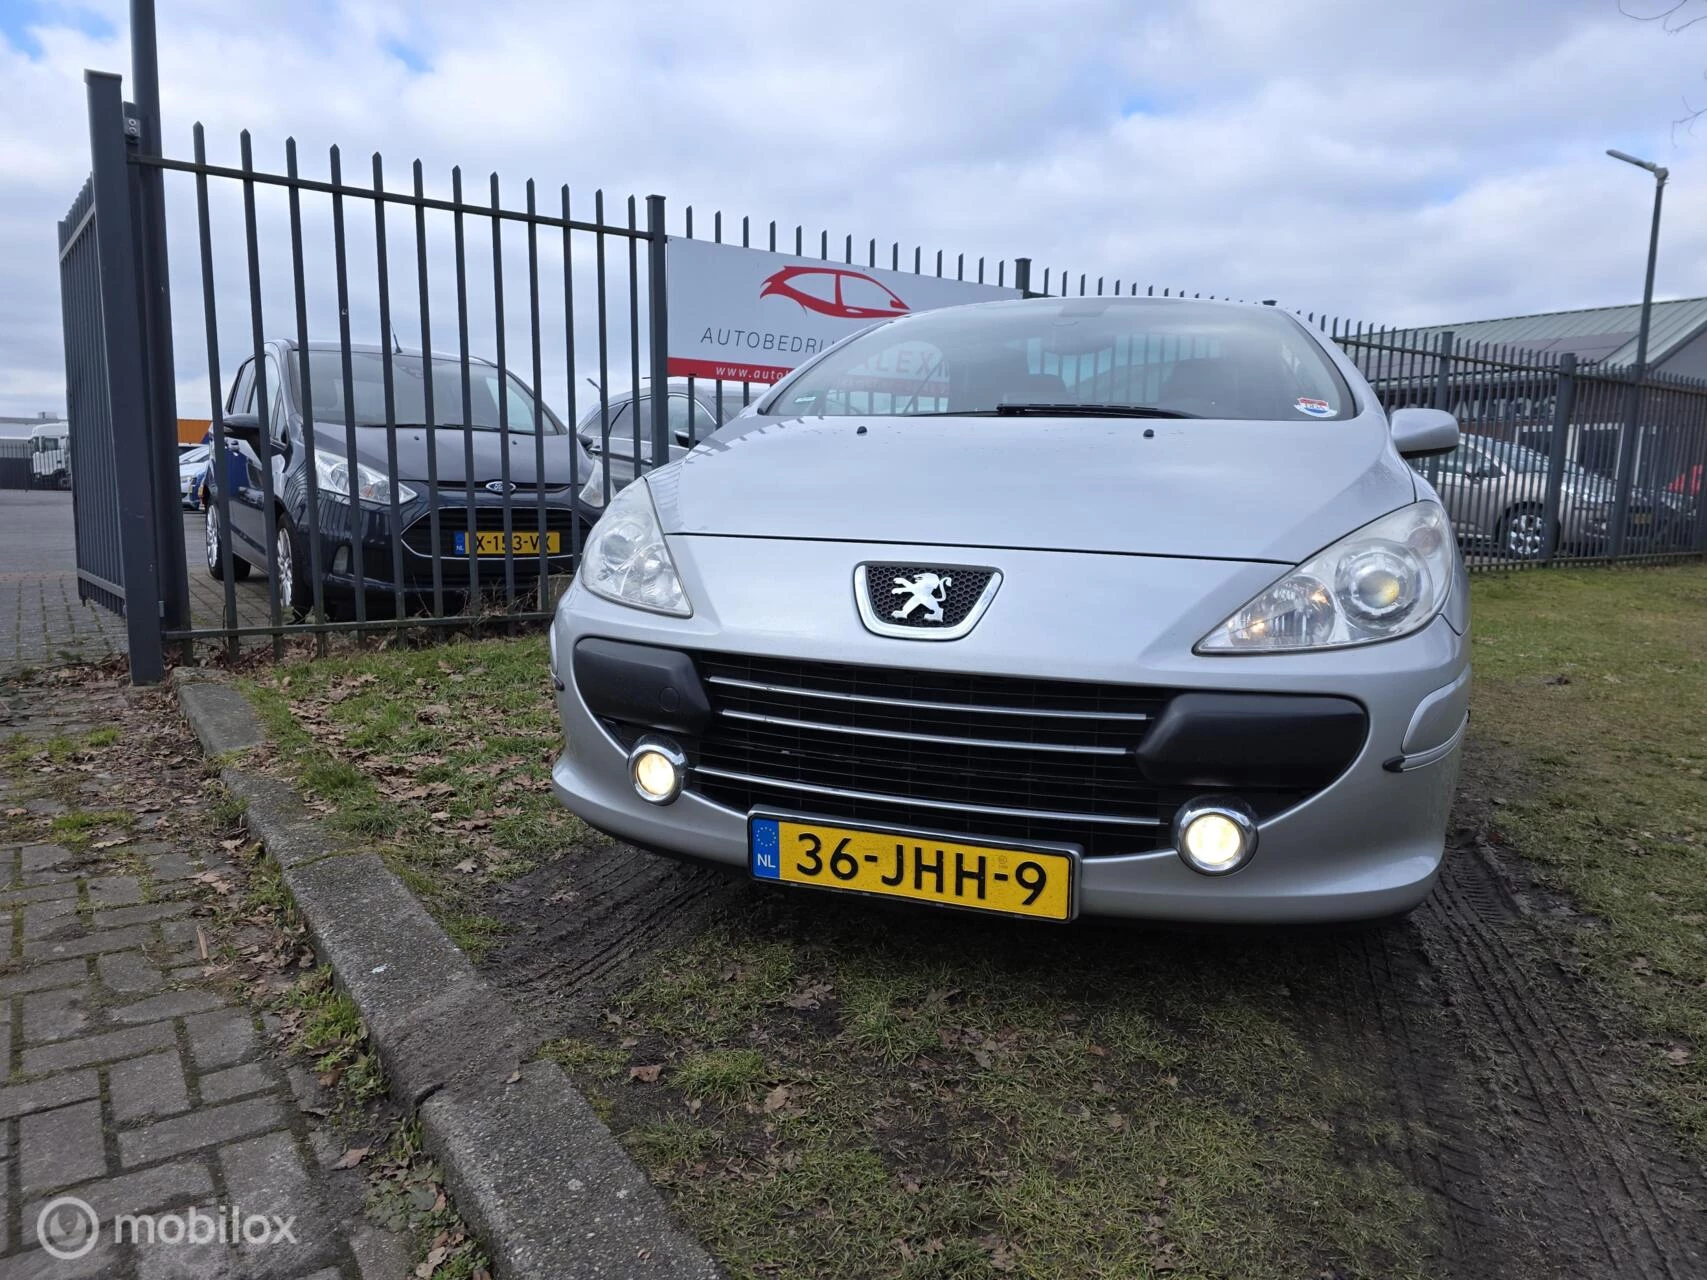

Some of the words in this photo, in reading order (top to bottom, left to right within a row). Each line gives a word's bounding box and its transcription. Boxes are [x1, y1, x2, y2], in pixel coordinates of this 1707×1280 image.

[701, 327, 835, 353] AUTOBEDRI
[716, 366, 790, 380] www.auto
[757, 853, 776, 868] NL
[796, 832, 1047, 906] 36-JHH-9
